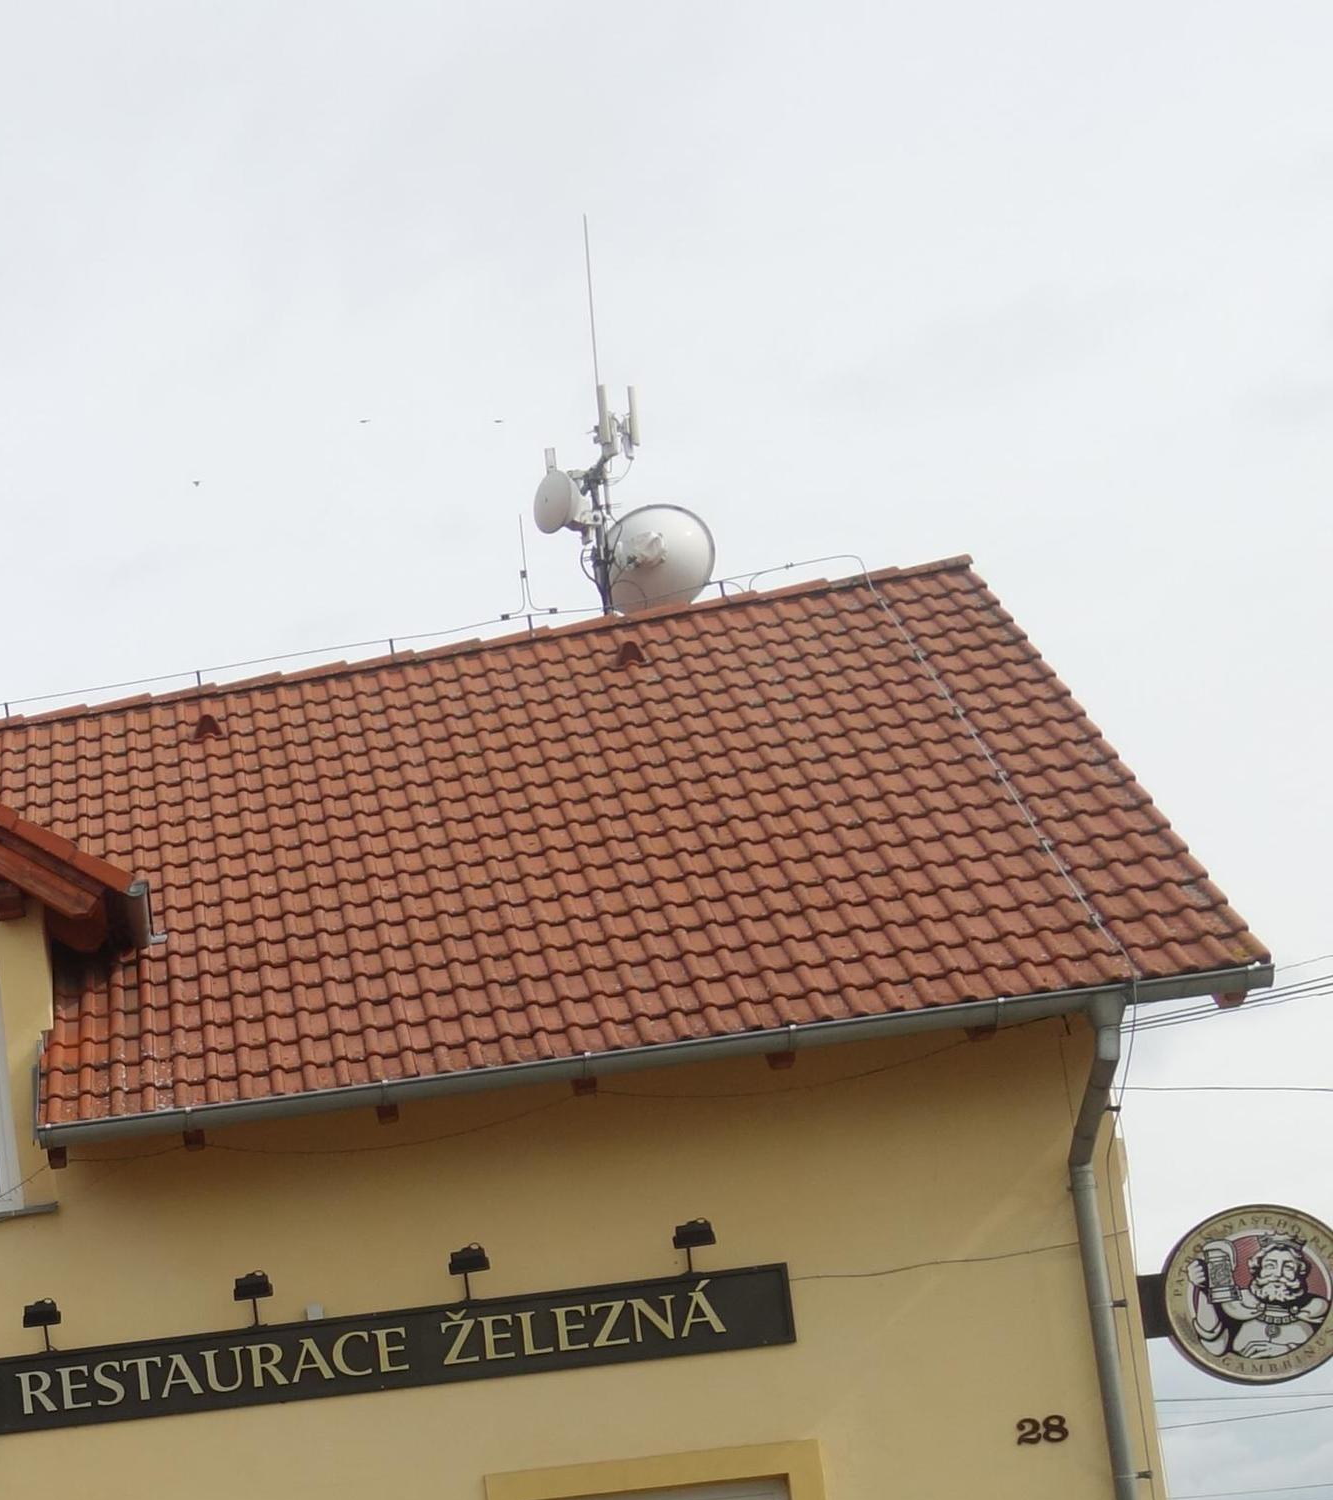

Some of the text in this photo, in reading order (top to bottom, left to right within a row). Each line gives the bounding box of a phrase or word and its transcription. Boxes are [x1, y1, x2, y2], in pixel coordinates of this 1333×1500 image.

[15, 1279, 728, 1416] RESTAURACE ŽELEZNÁ
[1016, 1414, 1069, 1446] 28
